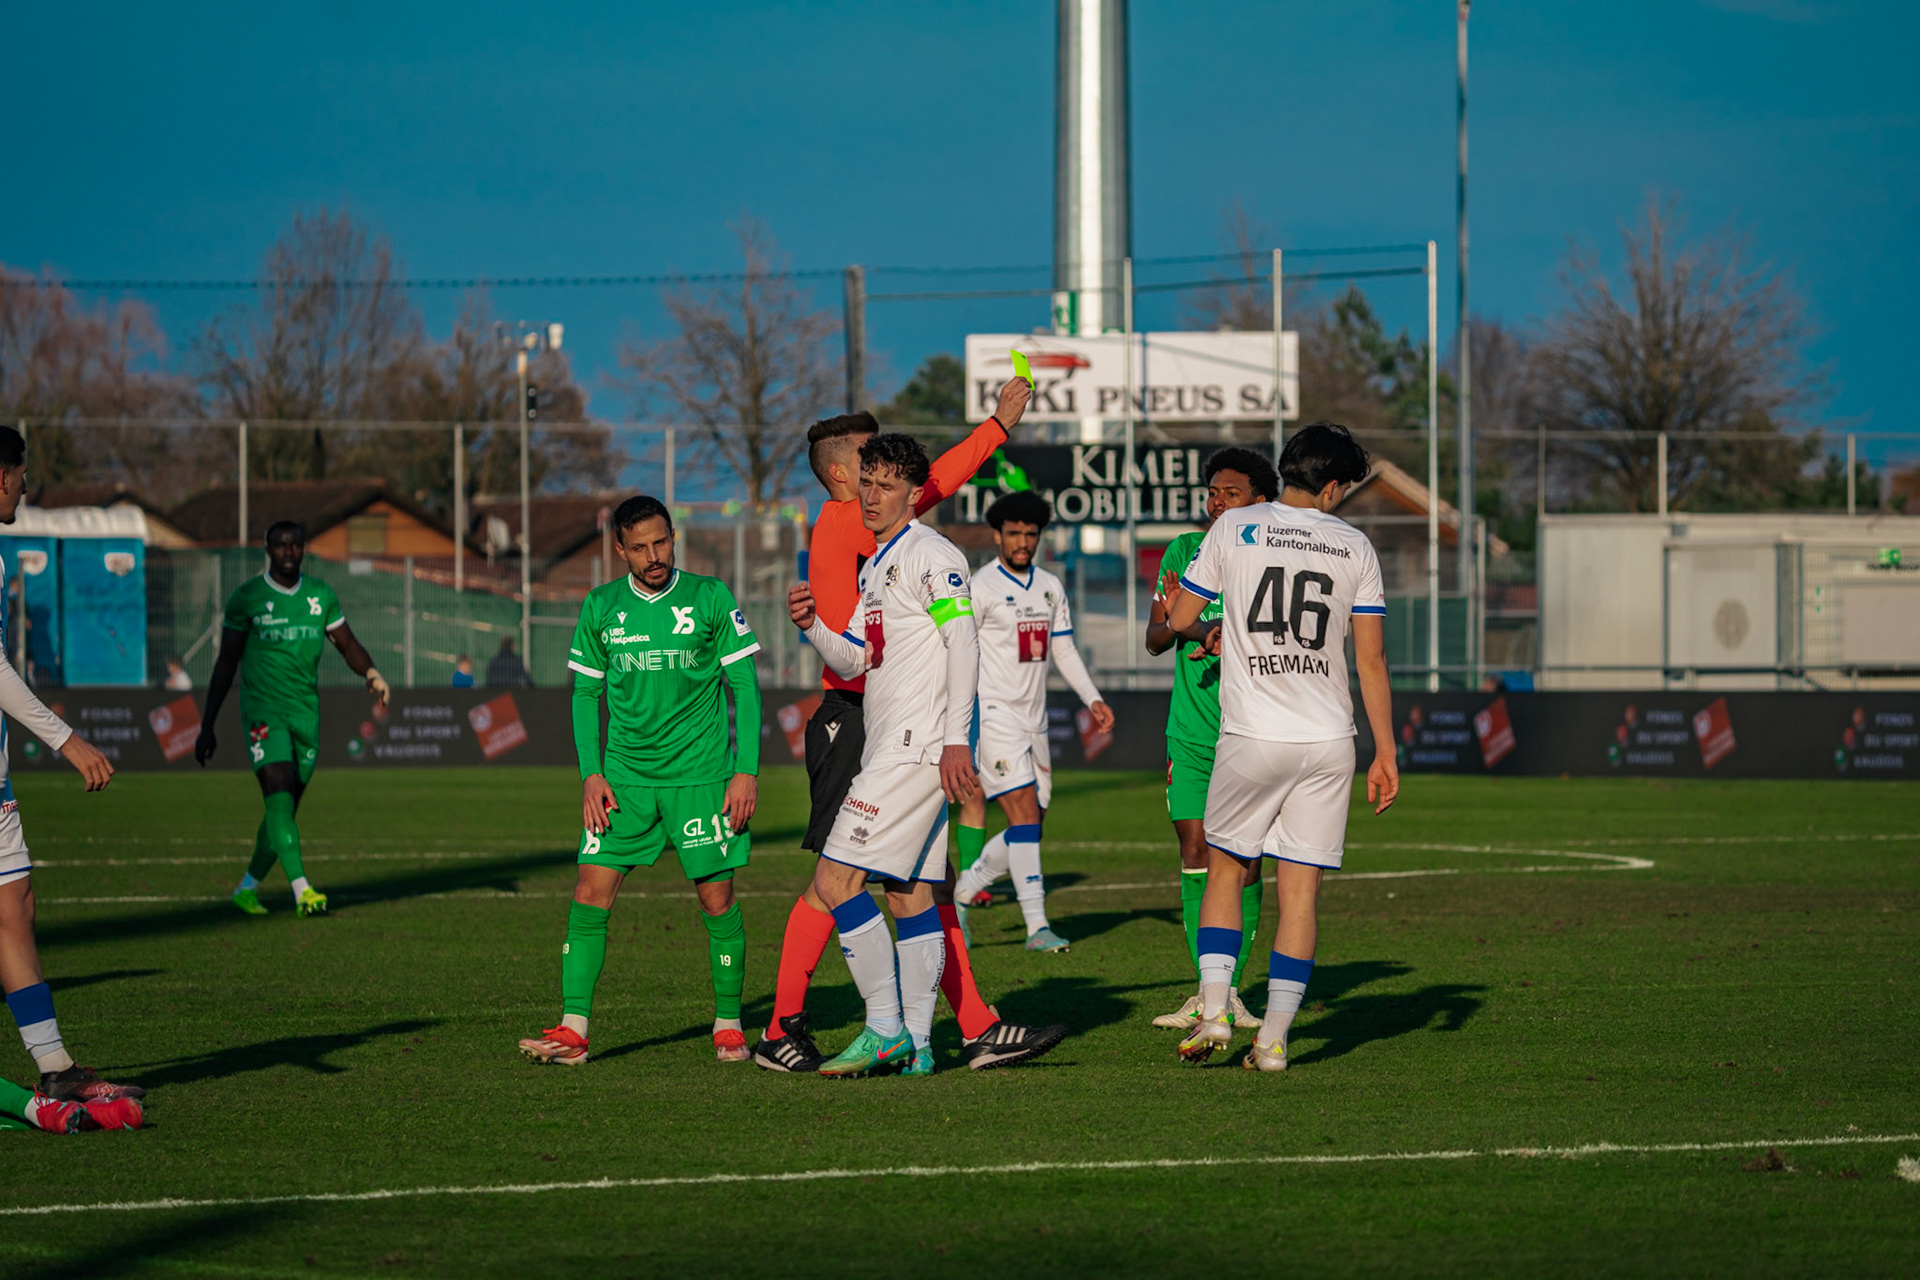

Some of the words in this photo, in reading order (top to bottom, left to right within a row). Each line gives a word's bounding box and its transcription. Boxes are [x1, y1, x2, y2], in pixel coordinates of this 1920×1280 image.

[1096, 384, 1224, 413] PNEUS
[1238, 383, 1290, 412] SA
[1072, 445, 1200, 487] KIMEI
[966, 484, 1209, 522] IOBILIER
[1267, 525, 1312, 538] Luzerner
[1266, 537, 1351, 559] Kantonalbank
[1247, 566, 1334, 651] 46
[609, 627, 625, 637] UBS
[719, 954, 731, 966] 19
